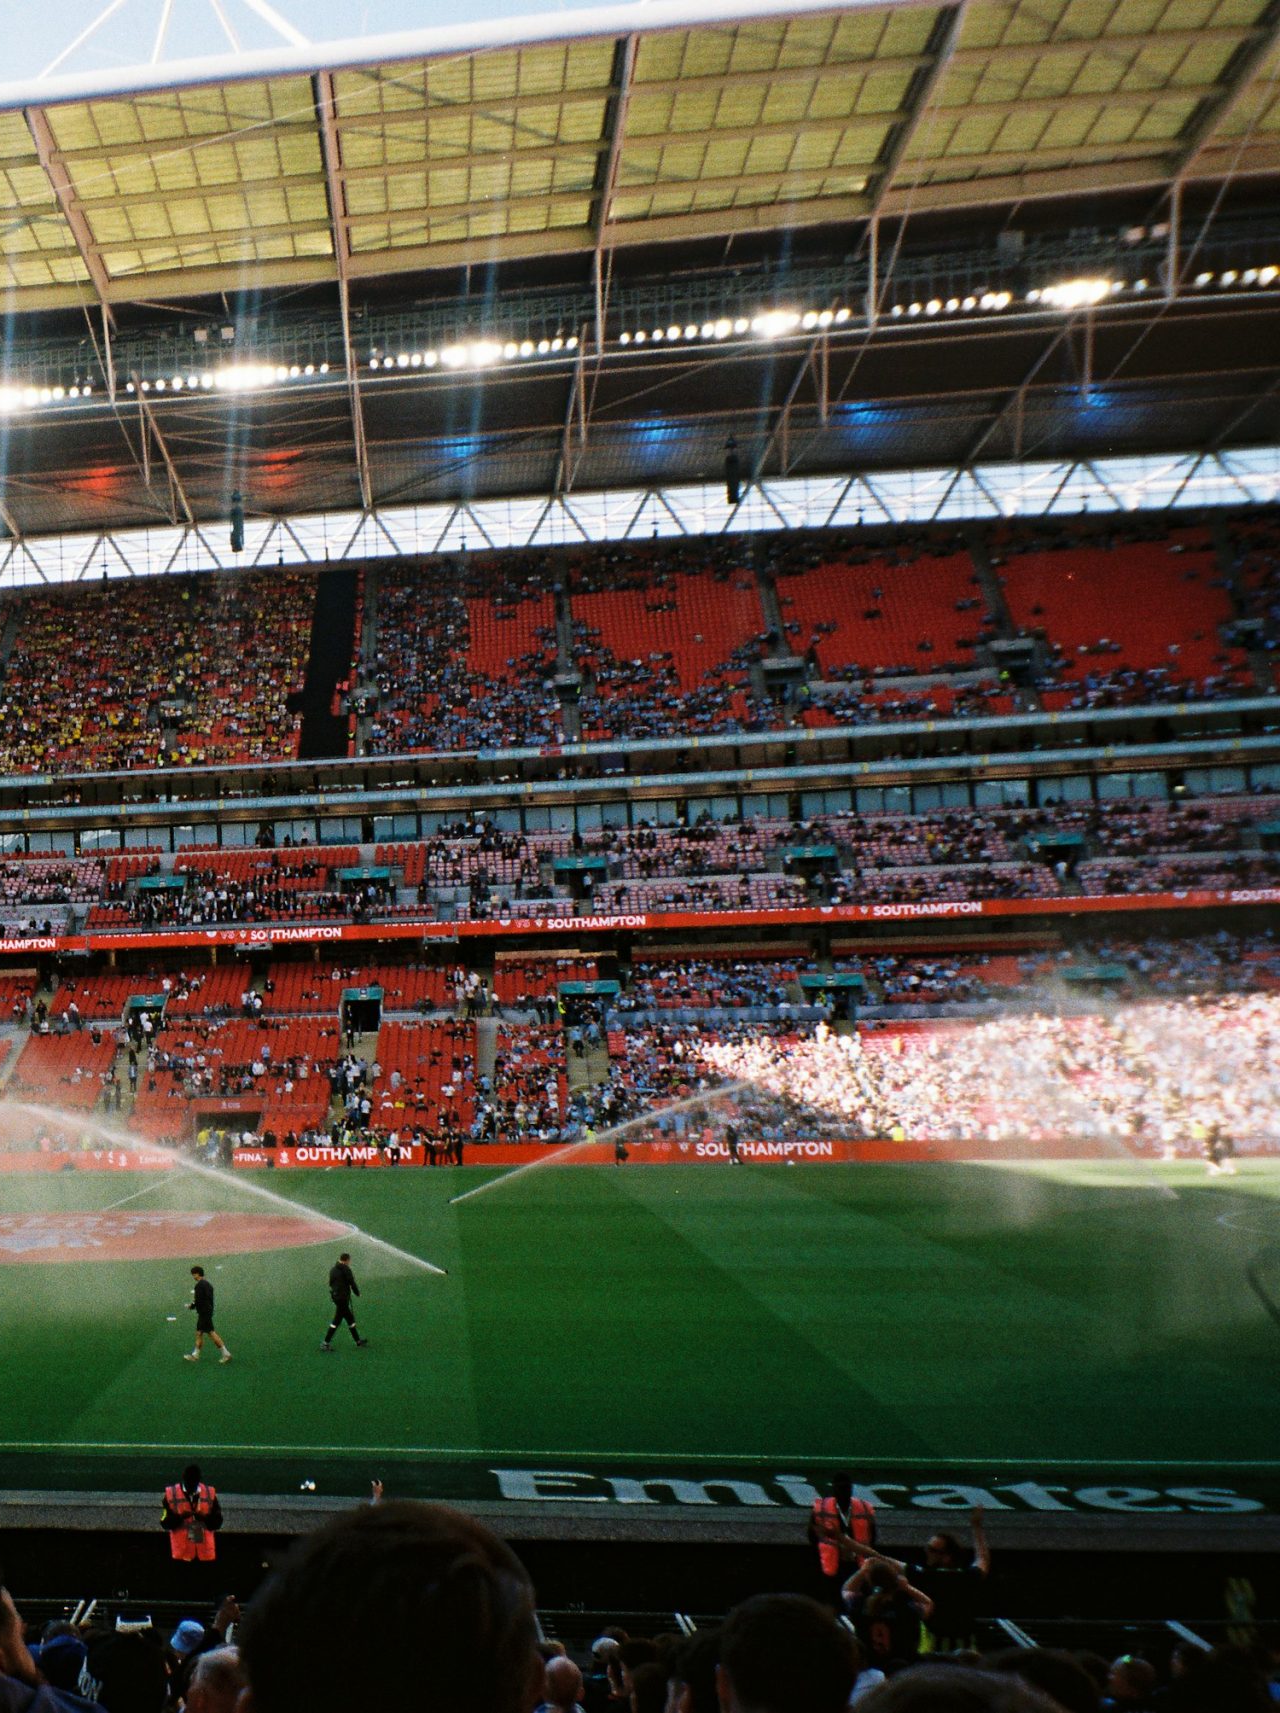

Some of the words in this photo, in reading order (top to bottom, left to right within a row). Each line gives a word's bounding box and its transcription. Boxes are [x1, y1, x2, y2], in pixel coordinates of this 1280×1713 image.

[873, 902, 982, 916] SOUTHAMPTON
[547, 915, 646, 929] SOUTHAMPTON
[251, 928, 342, 940] SOUTHAMPTON
[490, 1469, 1266, 1513] Emirates
